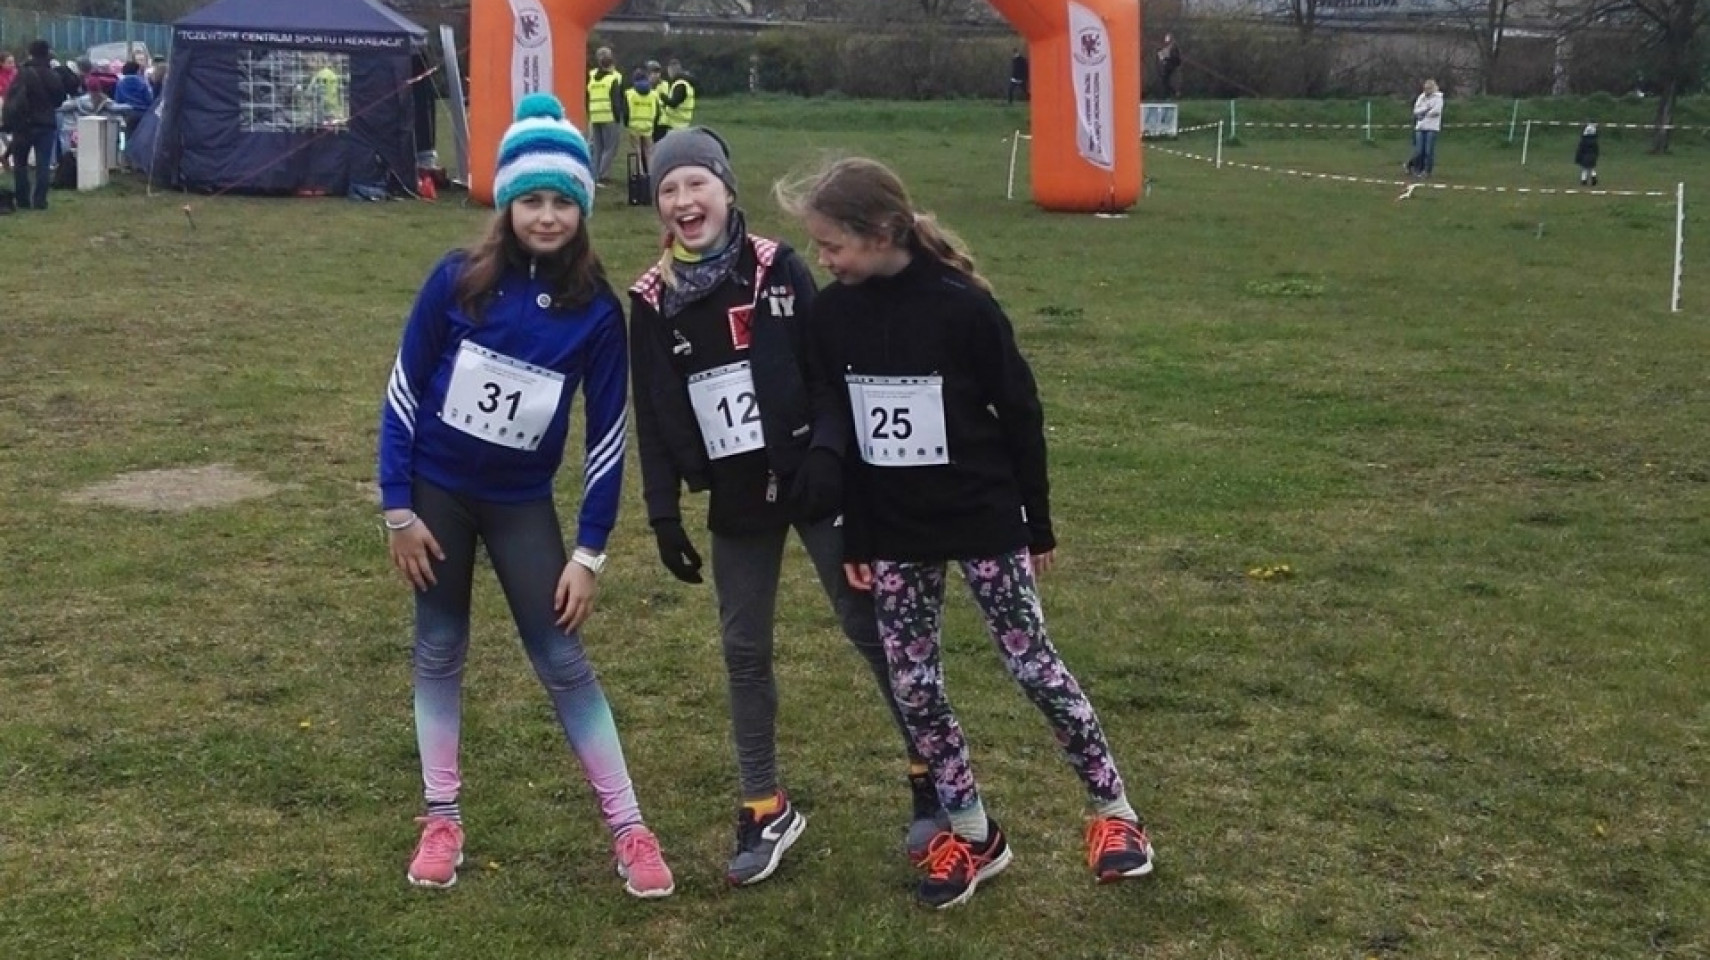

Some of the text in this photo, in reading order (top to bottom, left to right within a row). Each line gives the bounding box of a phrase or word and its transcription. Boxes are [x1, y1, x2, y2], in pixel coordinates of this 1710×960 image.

[241, 31, 293, 42] CENTRUM
[477, 381, 523, 422] 31
[716, 391, 761, 428] 12
[870, 406, 913, 440] 25
